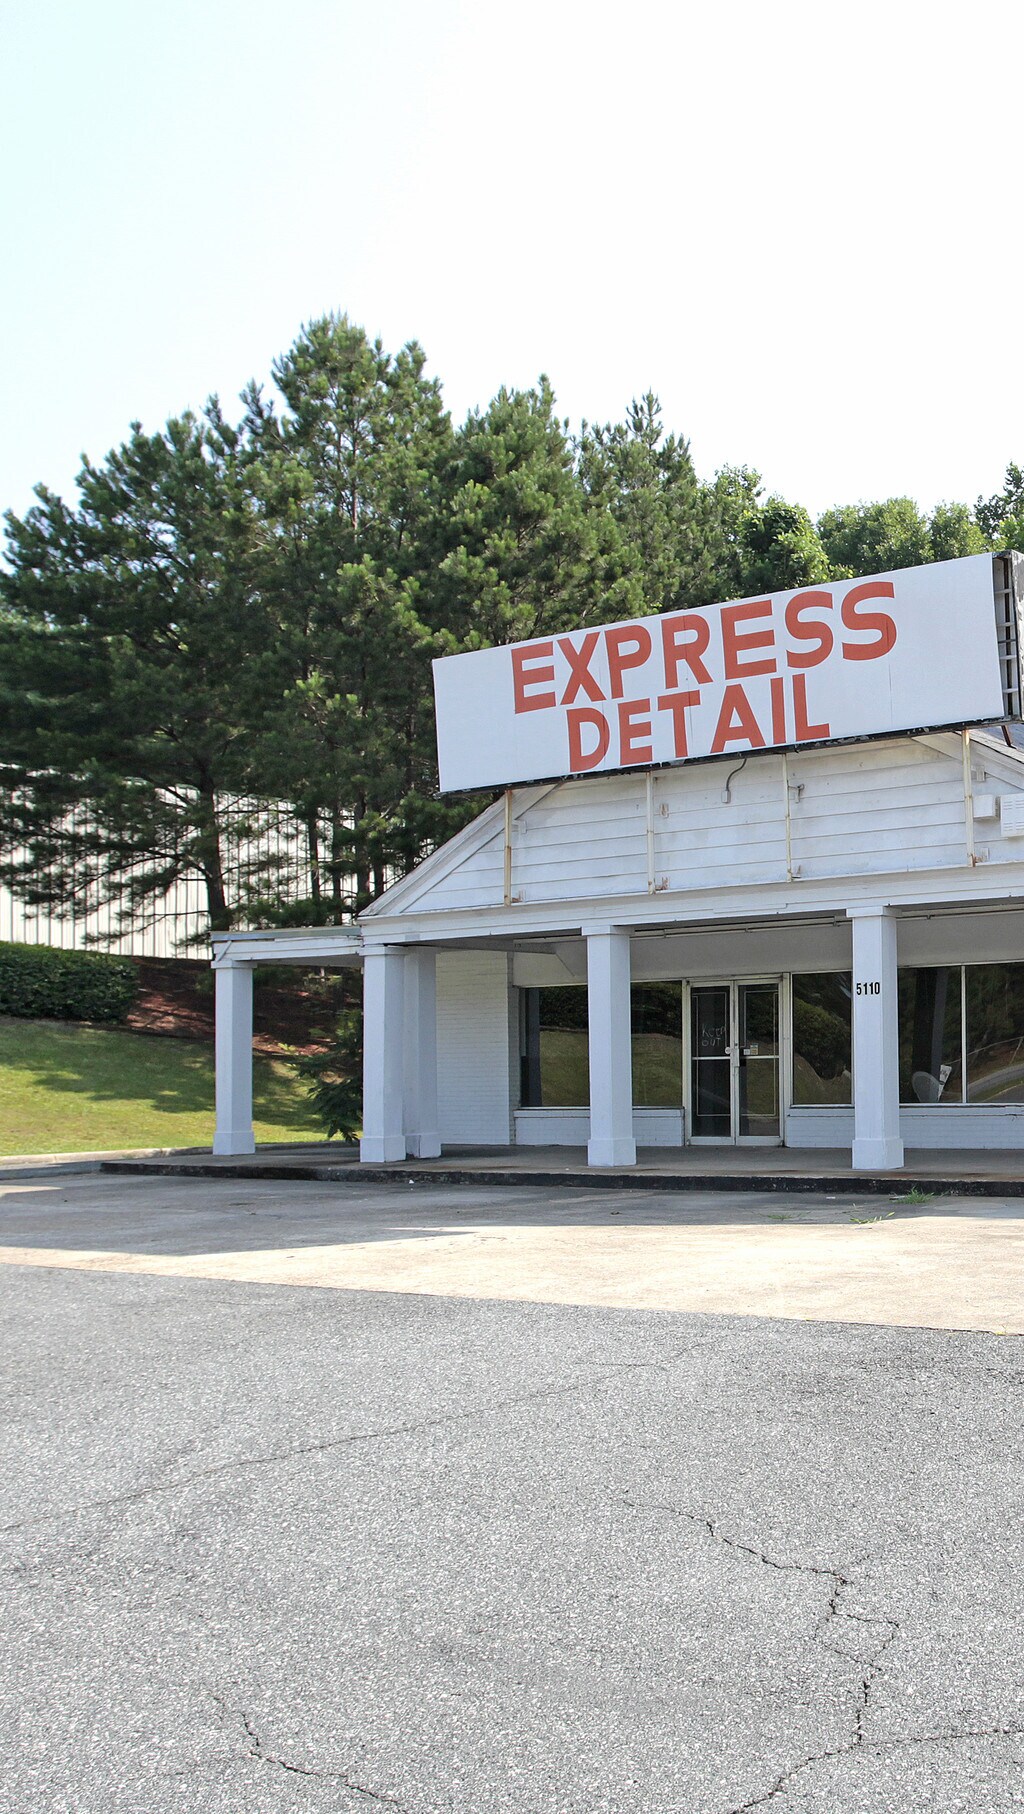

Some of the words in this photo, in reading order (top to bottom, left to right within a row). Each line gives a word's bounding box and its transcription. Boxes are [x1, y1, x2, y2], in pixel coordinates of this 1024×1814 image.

[511, 581, 898, 714] EXPRESS
[567, 673, 830, 772] DETAIL
[856, 981, 880, 996] 5110
